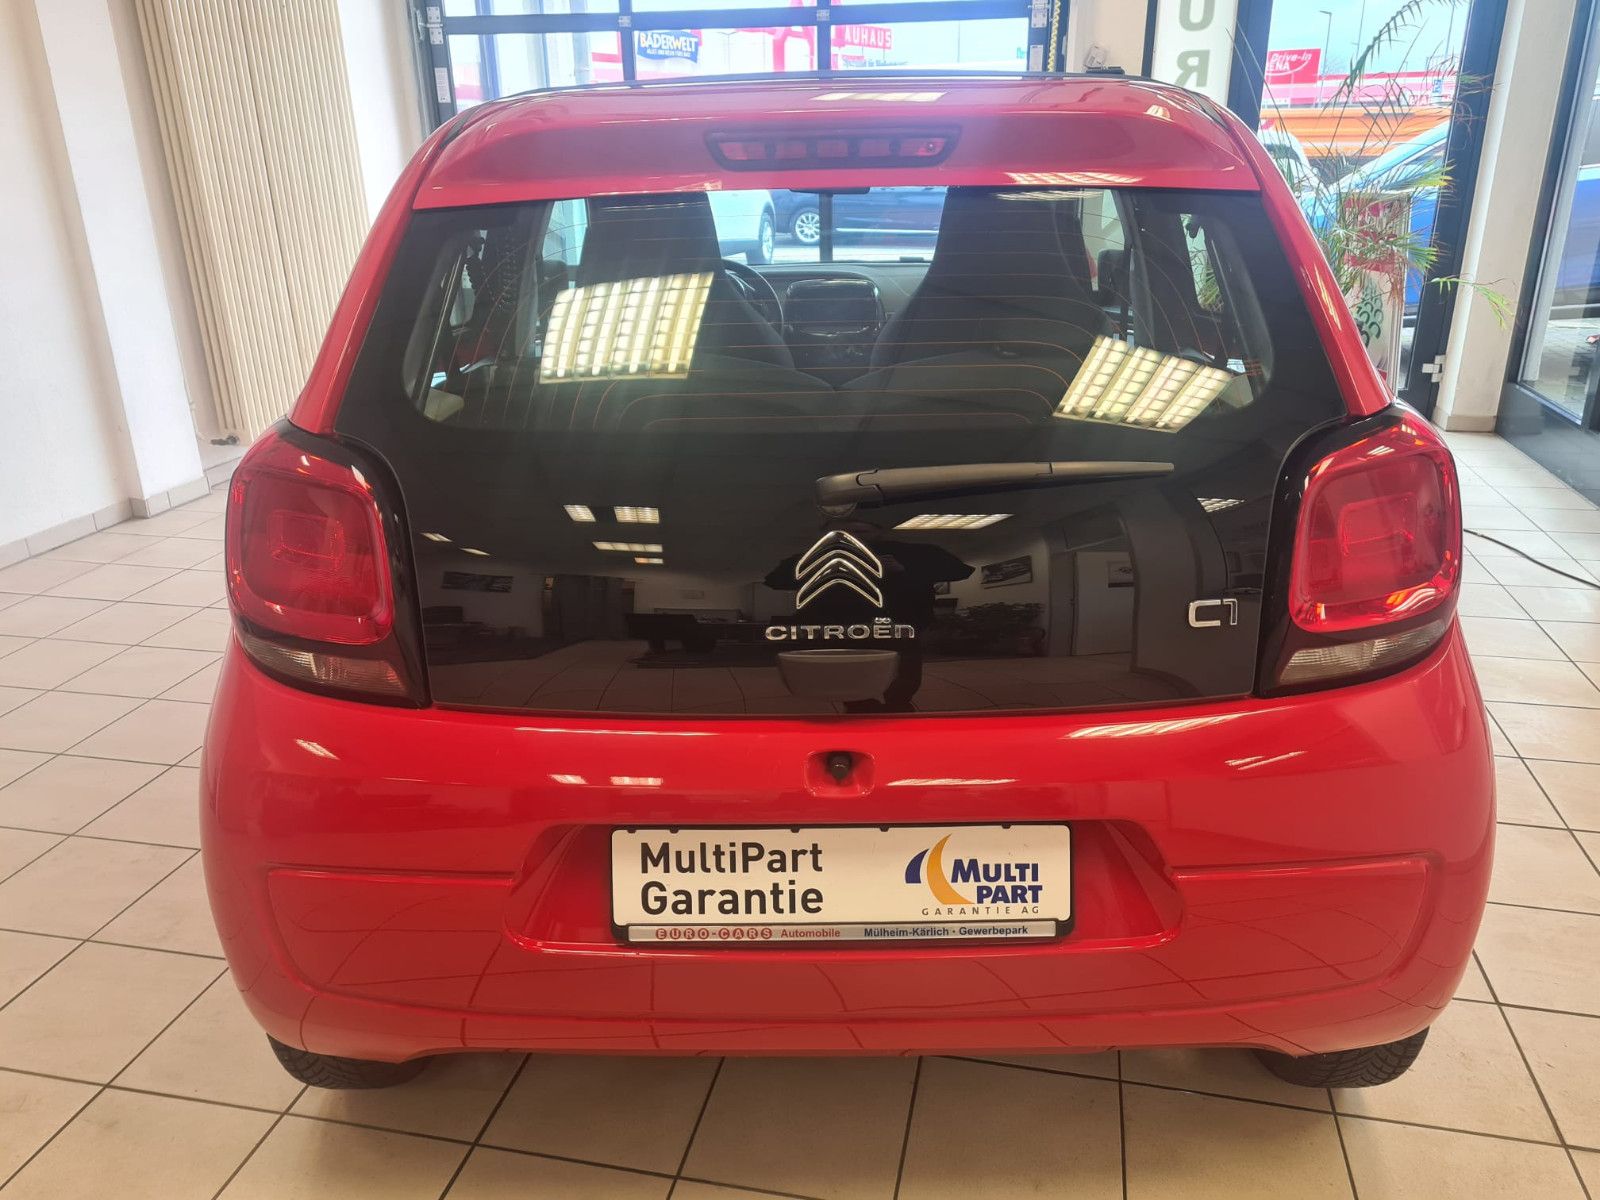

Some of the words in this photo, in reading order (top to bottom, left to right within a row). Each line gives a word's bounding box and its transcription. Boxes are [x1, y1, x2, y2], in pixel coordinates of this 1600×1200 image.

[845, 26, 892, 48] AUHAUS
[1267, 60, 1290, 71] ENA
[1188, 598, 1238, 628] C1
[765, 617, 915, 641] CITROËN
[640, 842, 823, 873] MultiPart
[951, 858, 1039, 883] MULTI
[641, 880, 823, 915] Garantie
[976, 885, 1043, 904] PART
[921, 906, 1011, 916] GARANTIE
[1021, 905, 1040, 914] AG
[655, 927, 773, 940] EURO-CARS
[780, 928, 841, 938] Automobile
[864, 926, 949, 937] Mülheim-Kärlich
[959, 926, 1028, 937] Gewerbepark
